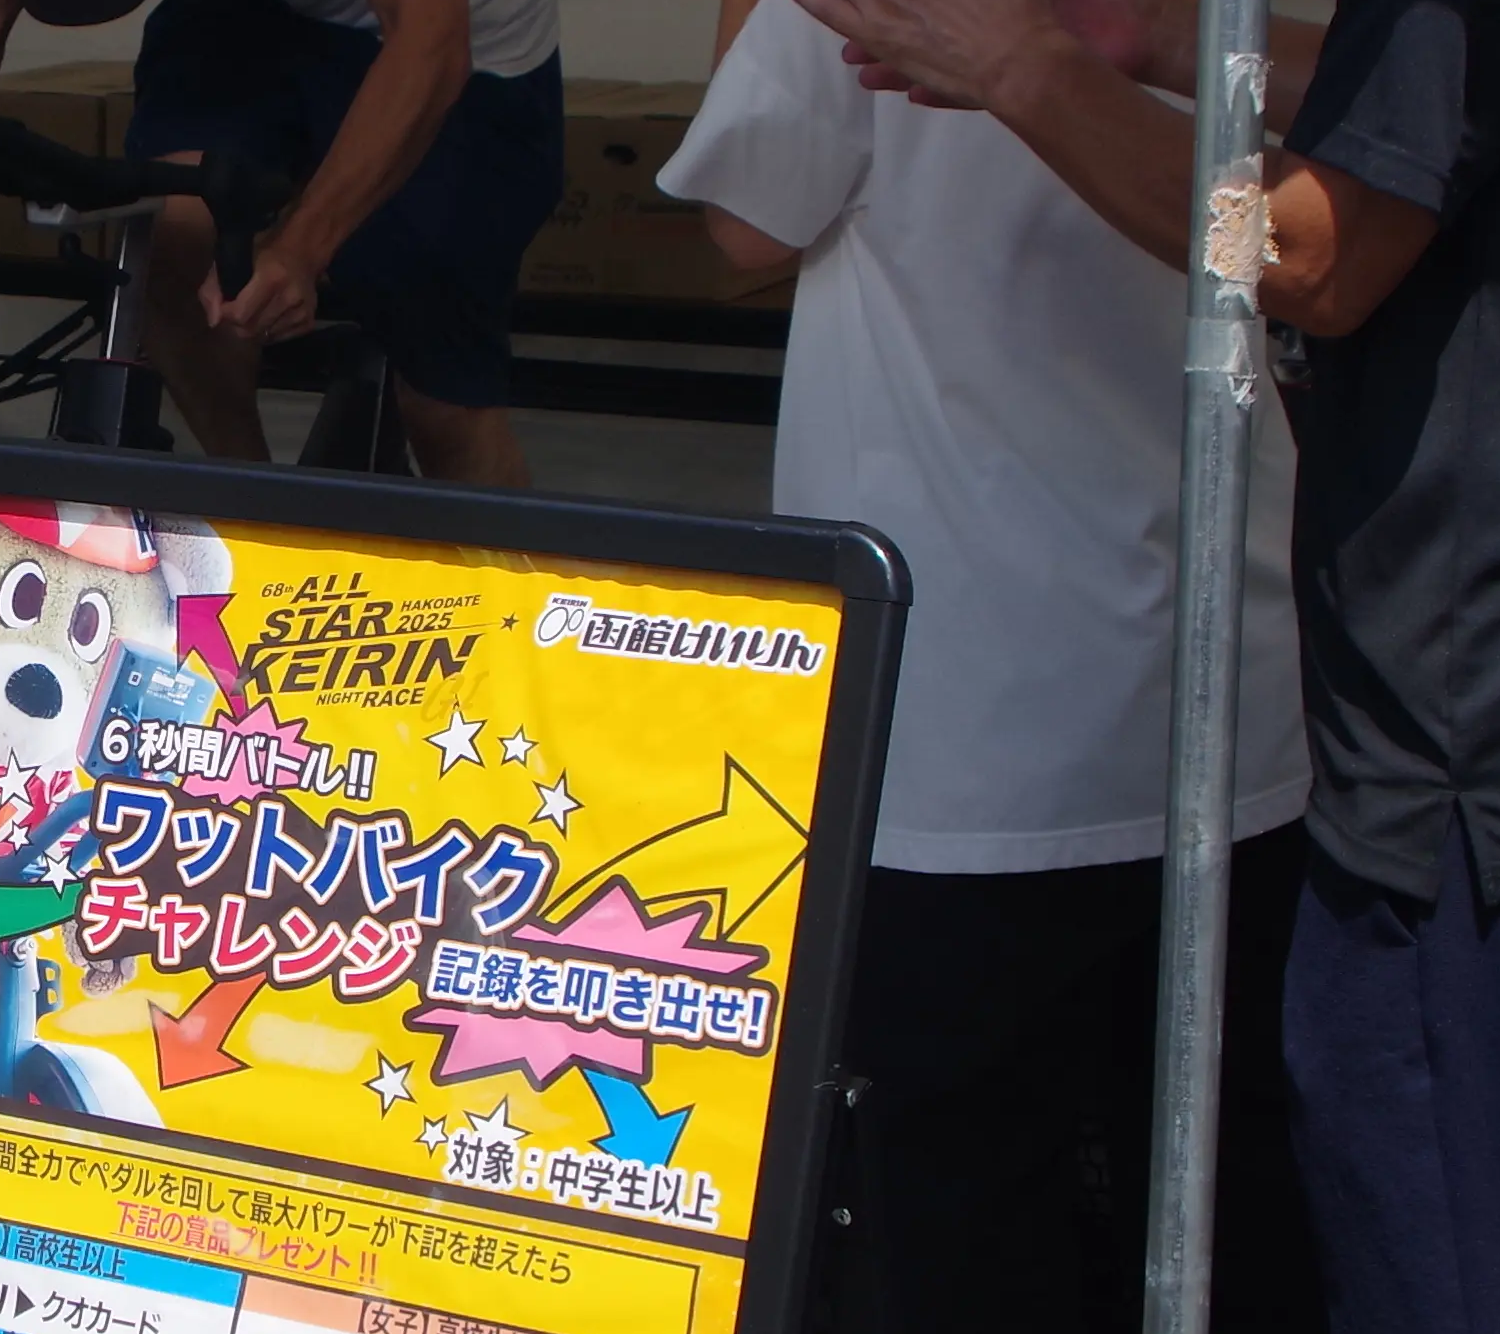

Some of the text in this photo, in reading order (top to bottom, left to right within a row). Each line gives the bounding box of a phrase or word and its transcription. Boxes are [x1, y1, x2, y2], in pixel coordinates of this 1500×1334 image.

[261, 572, 372, 605] 68th ALL
[260, 594, 482, 647] STAR HAKODATE
[397, 612, 454, 634] 2025
[581, 612, 822, 671] 函館けいりん
[239, 632, 488, 696] KEIRIN
[316, 691, 363, 706] NIGHT
[361, 687, 426, 709] RACE
[96, 784, 554, 934] ワットバイク
[82, 878, 418, 996] チャレンジ
[447, 1133, 720, 1227] 対象：中学生以上
